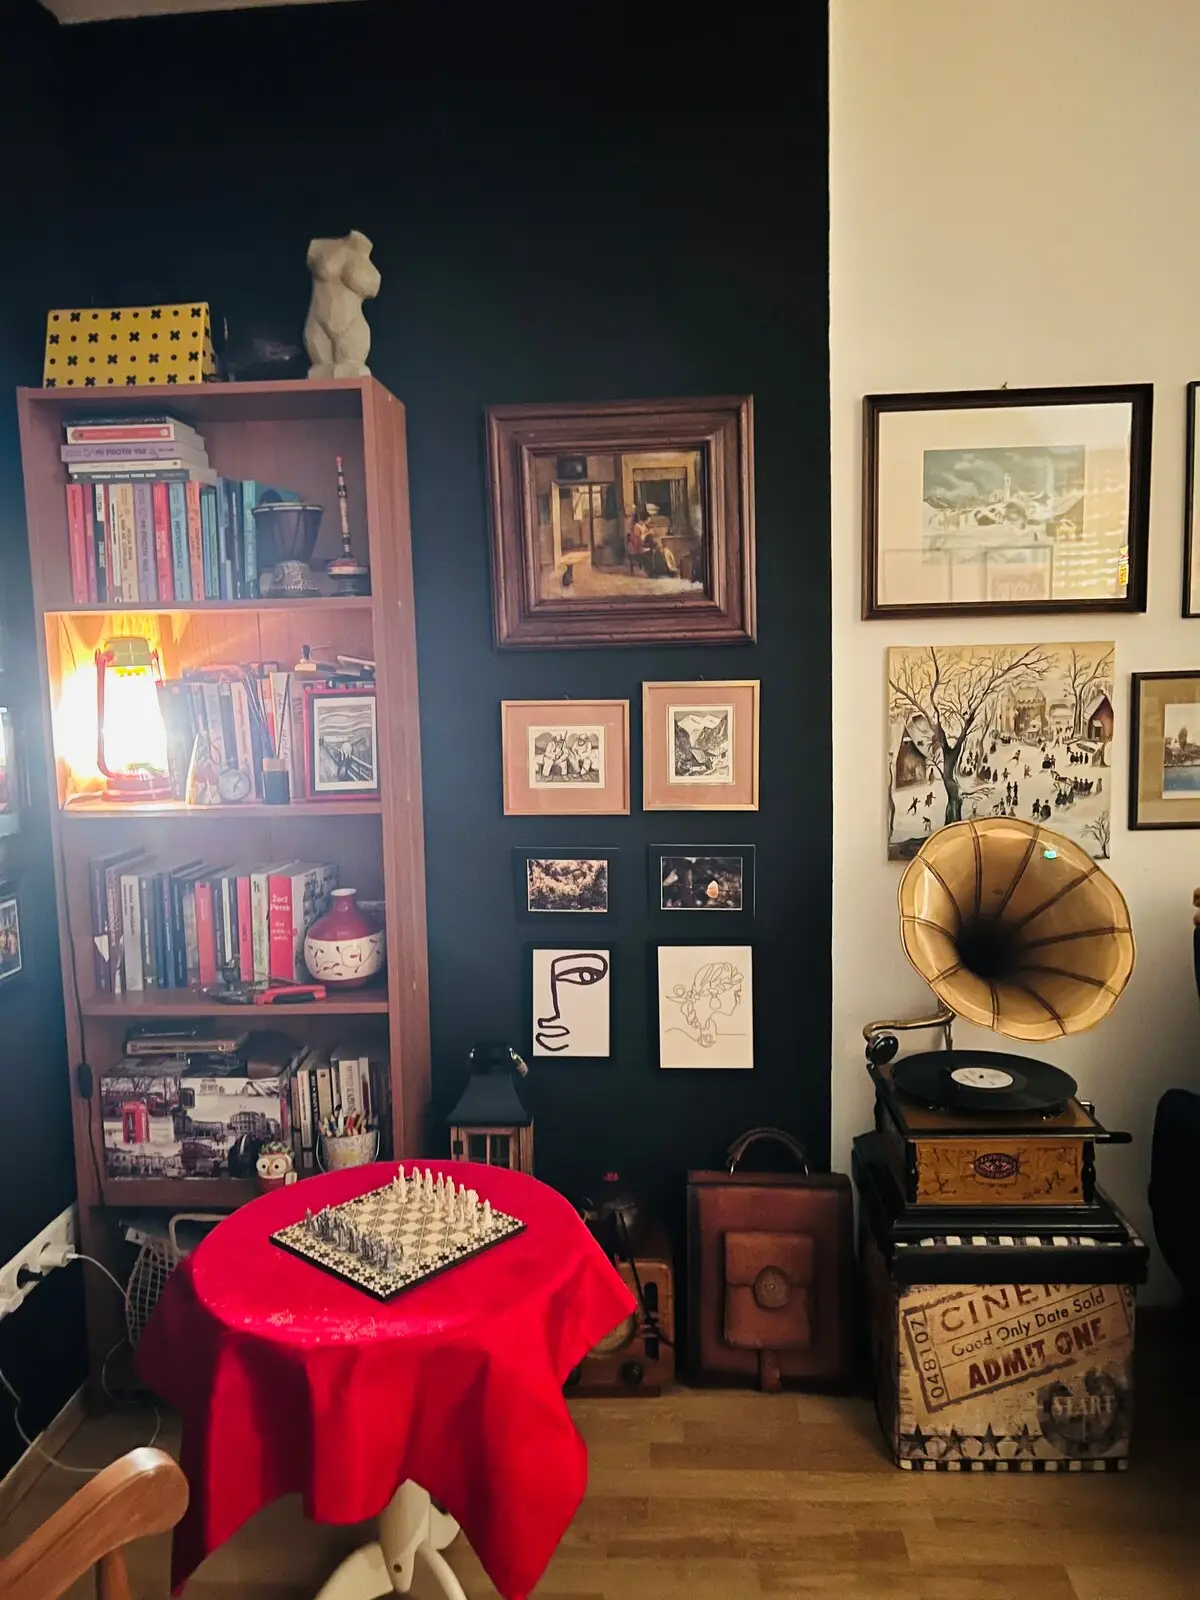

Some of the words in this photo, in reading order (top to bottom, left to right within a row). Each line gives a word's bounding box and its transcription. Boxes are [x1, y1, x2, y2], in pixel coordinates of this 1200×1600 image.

[951, 1331, 993, 1357] Good
[996, 1320, 1031, 1341] Only
[1035, 1308, 1069, 1328] Date
[1072, 1288, 1105, 1313] Sold
[969, 1339, 1046, 1390] ADMIT
[1055, 1317, 1107, 1355] ONE
